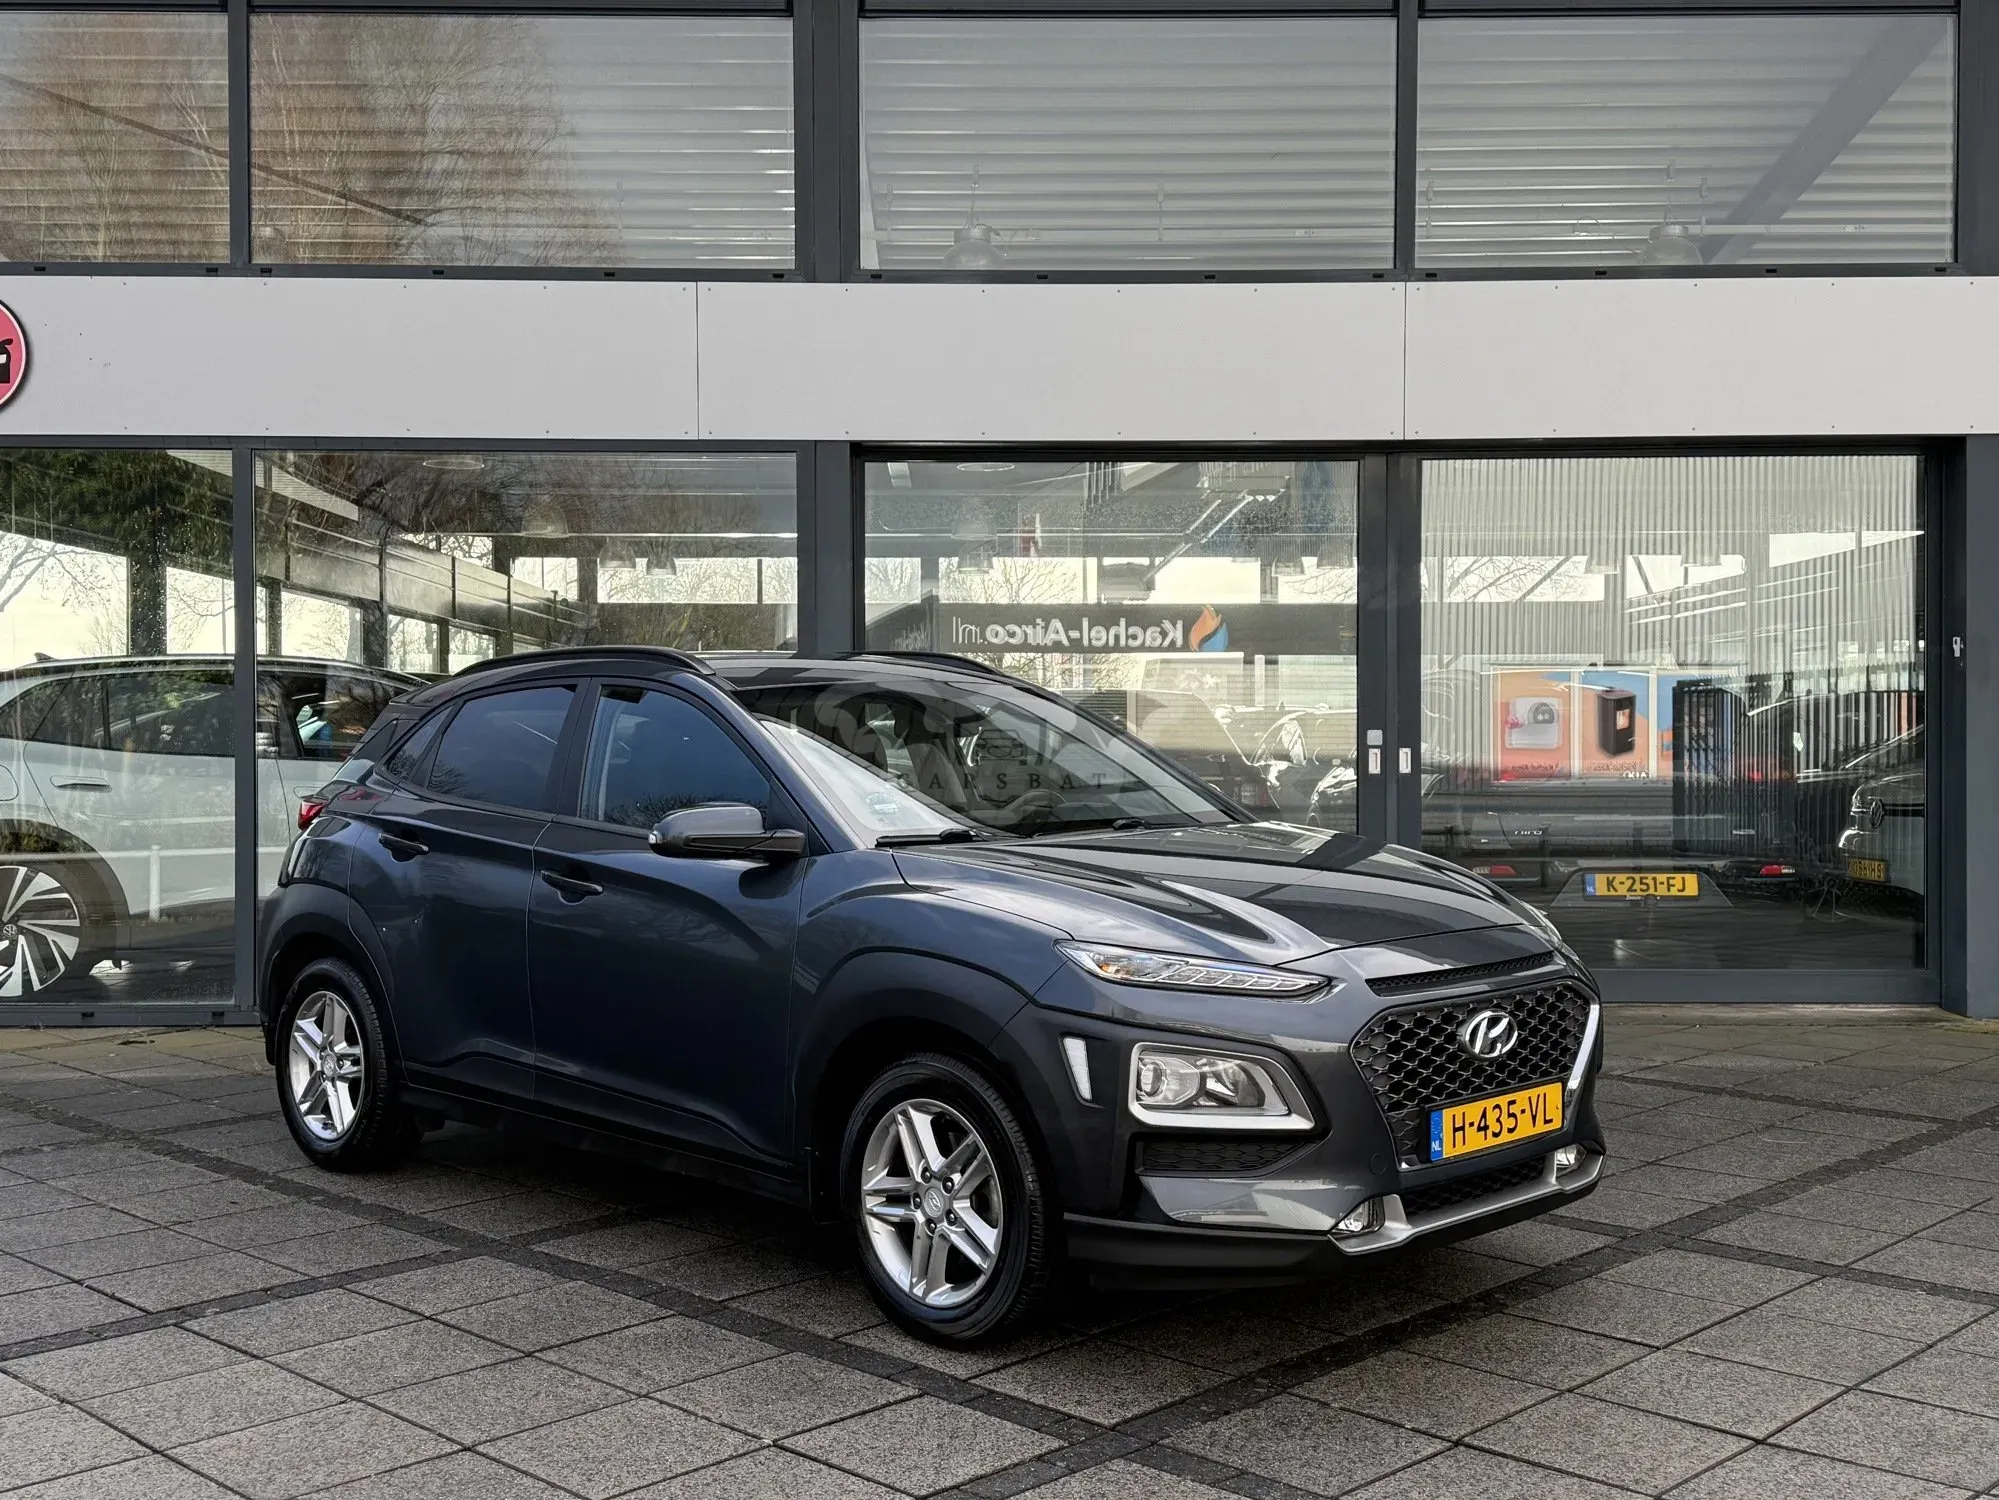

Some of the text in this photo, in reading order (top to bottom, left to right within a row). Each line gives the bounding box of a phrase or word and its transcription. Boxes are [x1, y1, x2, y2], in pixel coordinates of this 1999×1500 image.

[1606, 876, 1687, 892] K-251-FJ
[1452, 1092, 1554, 1148] H-435-VL
[1432, 1140, 1442, 1151] NL
